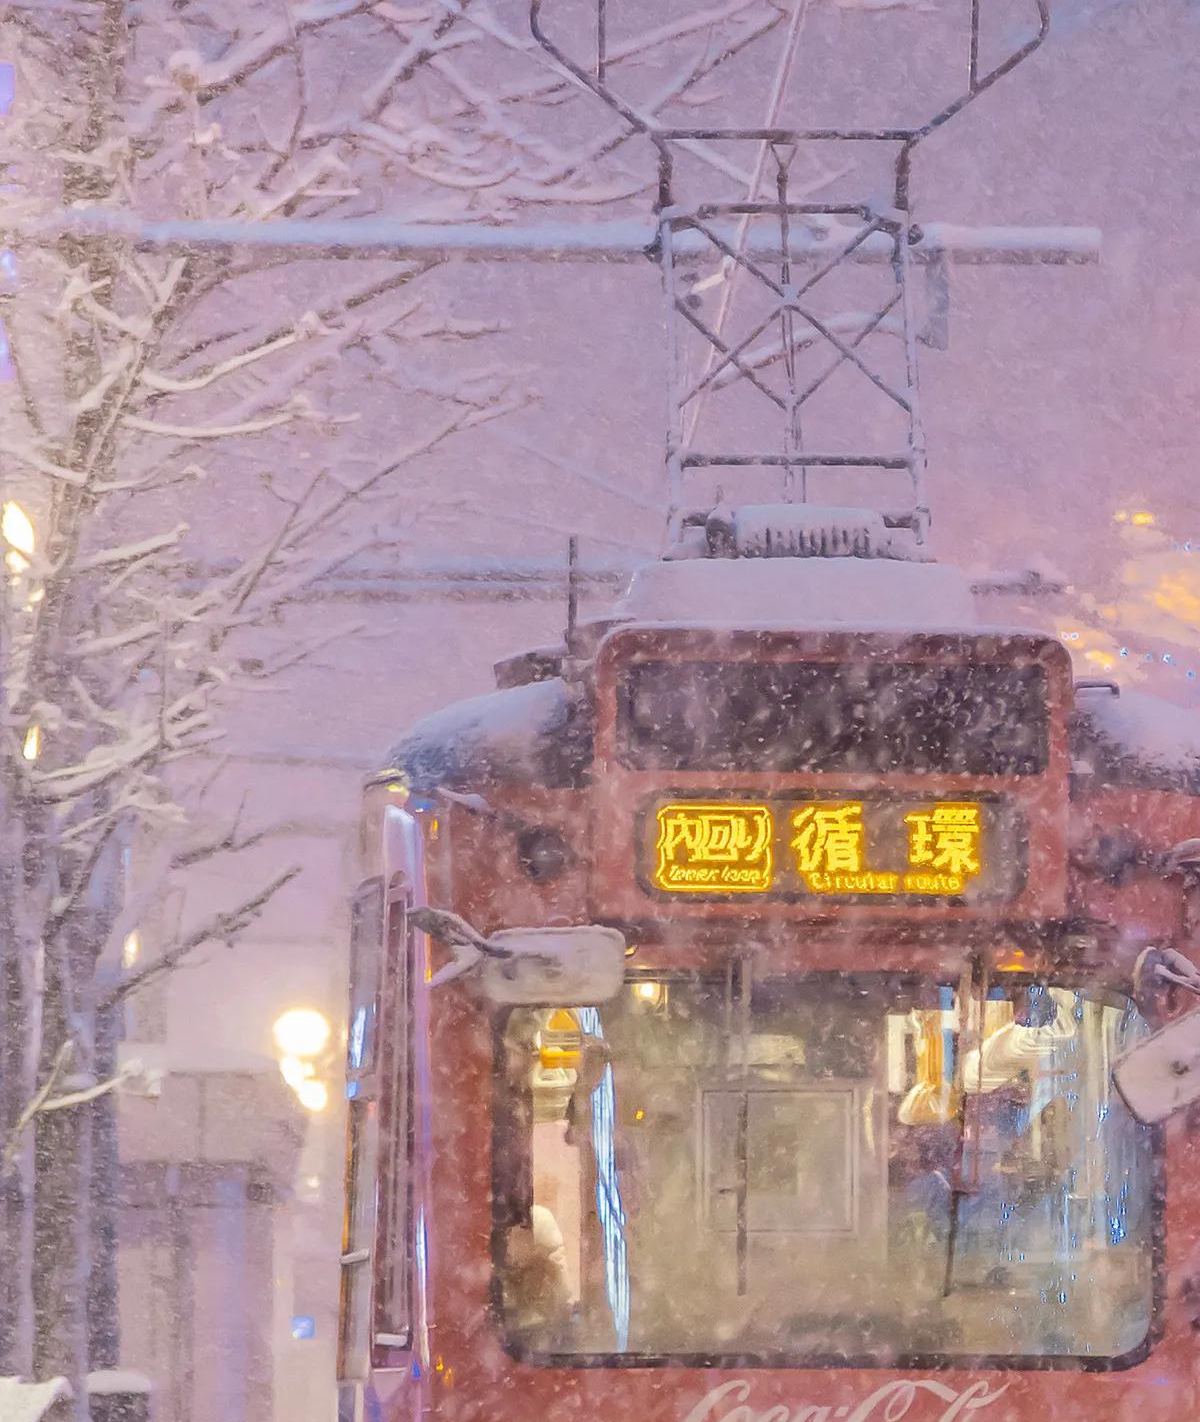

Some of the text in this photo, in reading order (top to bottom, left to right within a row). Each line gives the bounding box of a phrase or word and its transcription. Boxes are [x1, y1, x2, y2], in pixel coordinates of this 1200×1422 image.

[662, 812, 766, 862] 内回り
[669, 865, 761, 883] Inner loop
[809, 873, 961, 890] Circular route
